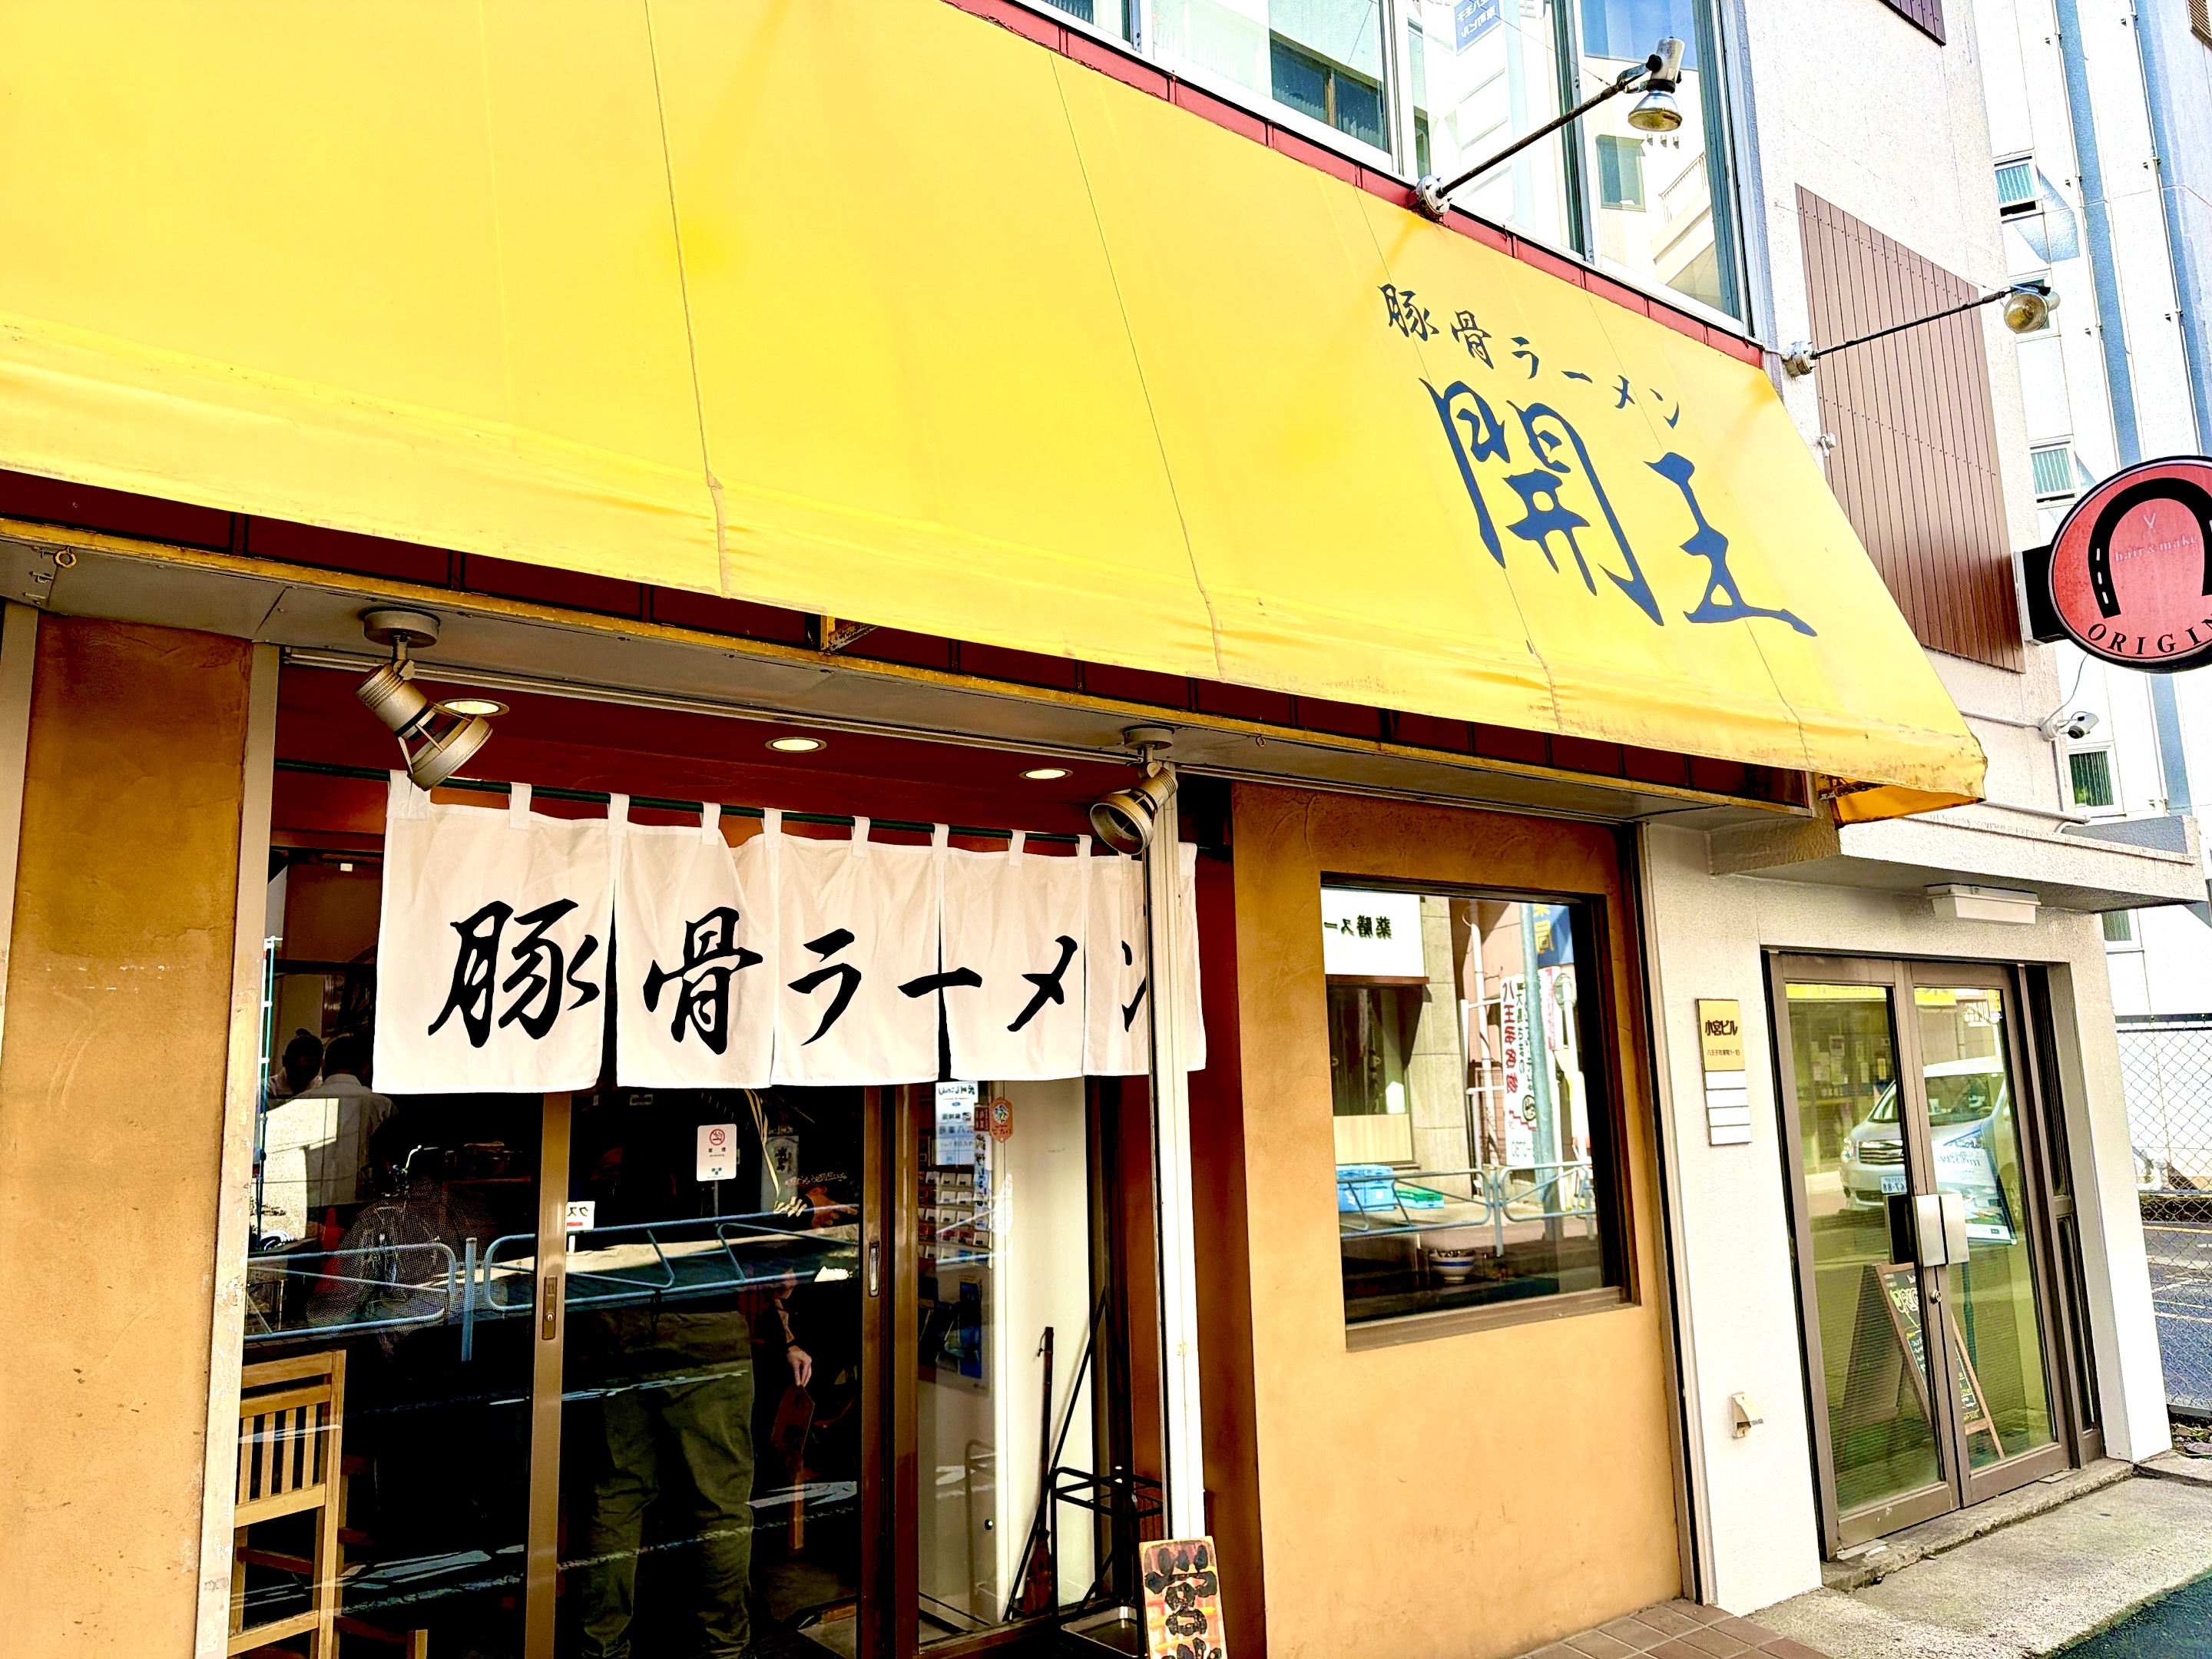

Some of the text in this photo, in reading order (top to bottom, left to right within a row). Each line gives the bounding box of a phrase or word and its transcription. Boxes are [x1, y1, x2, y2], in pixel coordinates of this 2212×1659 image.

[1378, 283, 1680, 429] 豚骨ラーメン
[2114, 547, 2144, 562] hair
[2160, 535, 2197, 552] make
[428, 898, 1147, 1056] 豚骨ラーメン
[1704, 1019, 1739, 1036] 小宮ビル
[1144, 1545, 1223, 1659] 営
